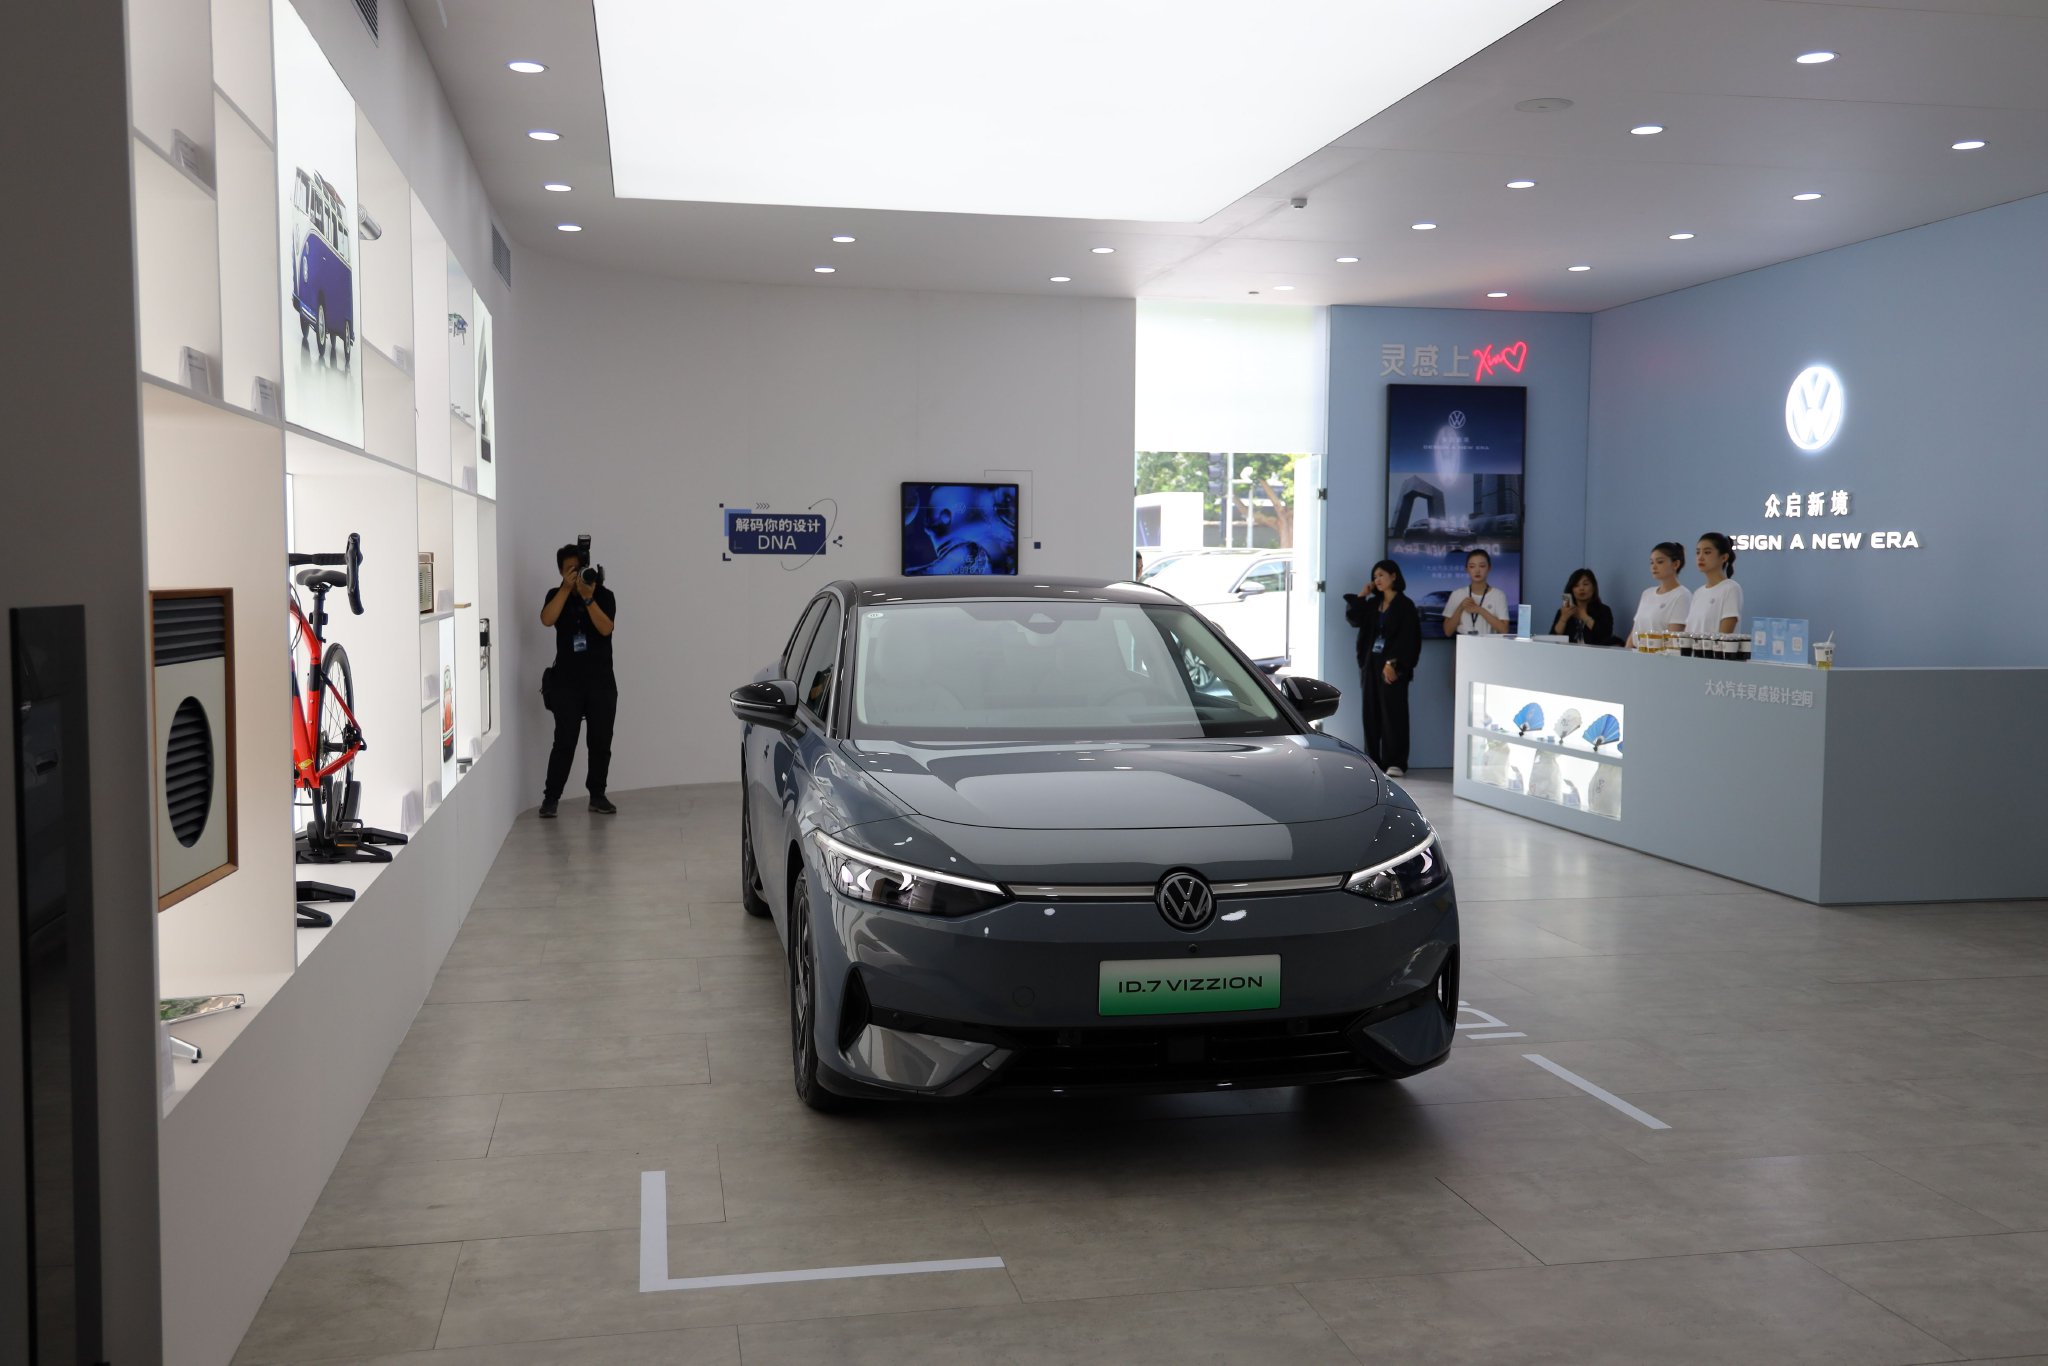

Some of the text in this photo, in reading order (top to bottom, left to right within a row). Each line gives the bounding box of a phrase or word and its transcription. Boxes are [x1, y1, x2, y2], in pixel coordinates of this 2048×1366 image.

[1379, 343, 1470, 377] 灵感上
[1764, 489, 1849, 518] 众启新境
[735, 518, 821, 533] 解码你的设计
[758, 535, 797, 550] DNA
[1729, 531, 1919, 551] SIGN A NEW ERA
[1704, 679, 1814, 708] 大众汽车灵感设计空间
[1118, 975, 1263, 993] ID.7 VIZZION
